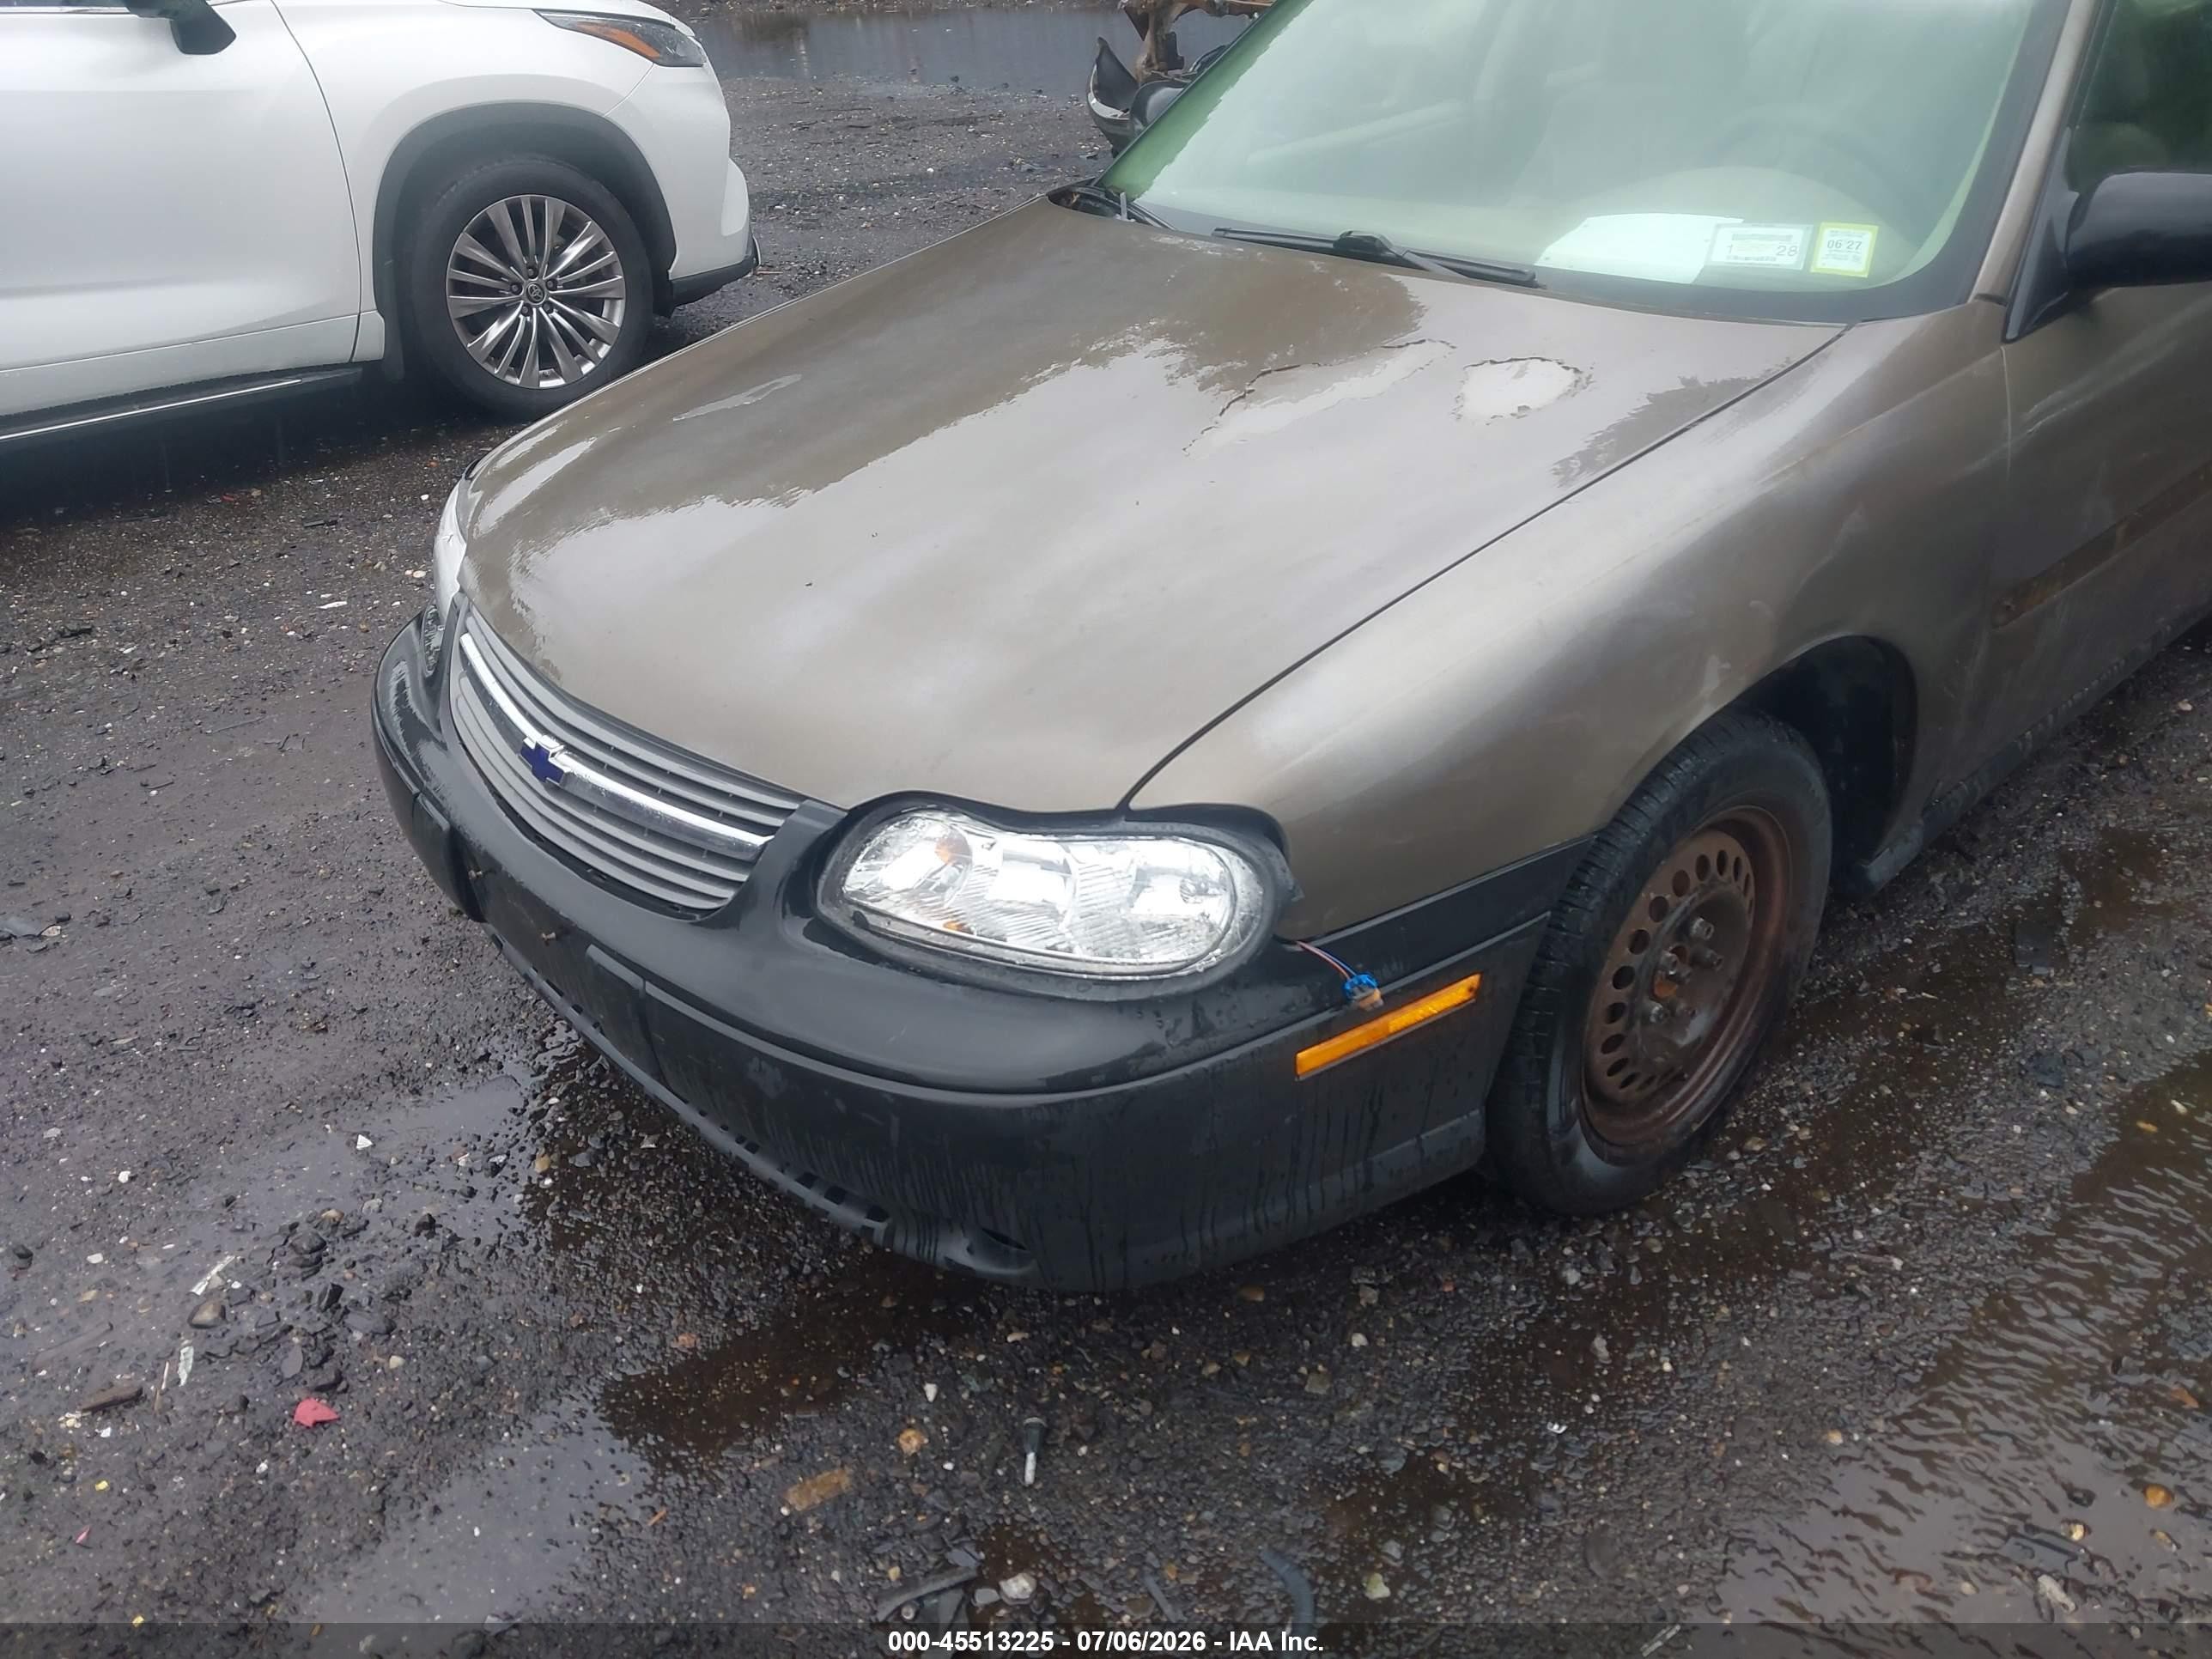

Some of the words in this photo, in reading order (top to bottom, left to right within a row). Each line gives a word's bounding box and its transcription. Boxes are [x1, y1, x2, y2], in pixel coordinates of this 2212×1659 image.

[1827, 240, 1842, 249] 06
[1846, 240, 1863, 250] 27
[1776, 245, 1798, 256] 28
